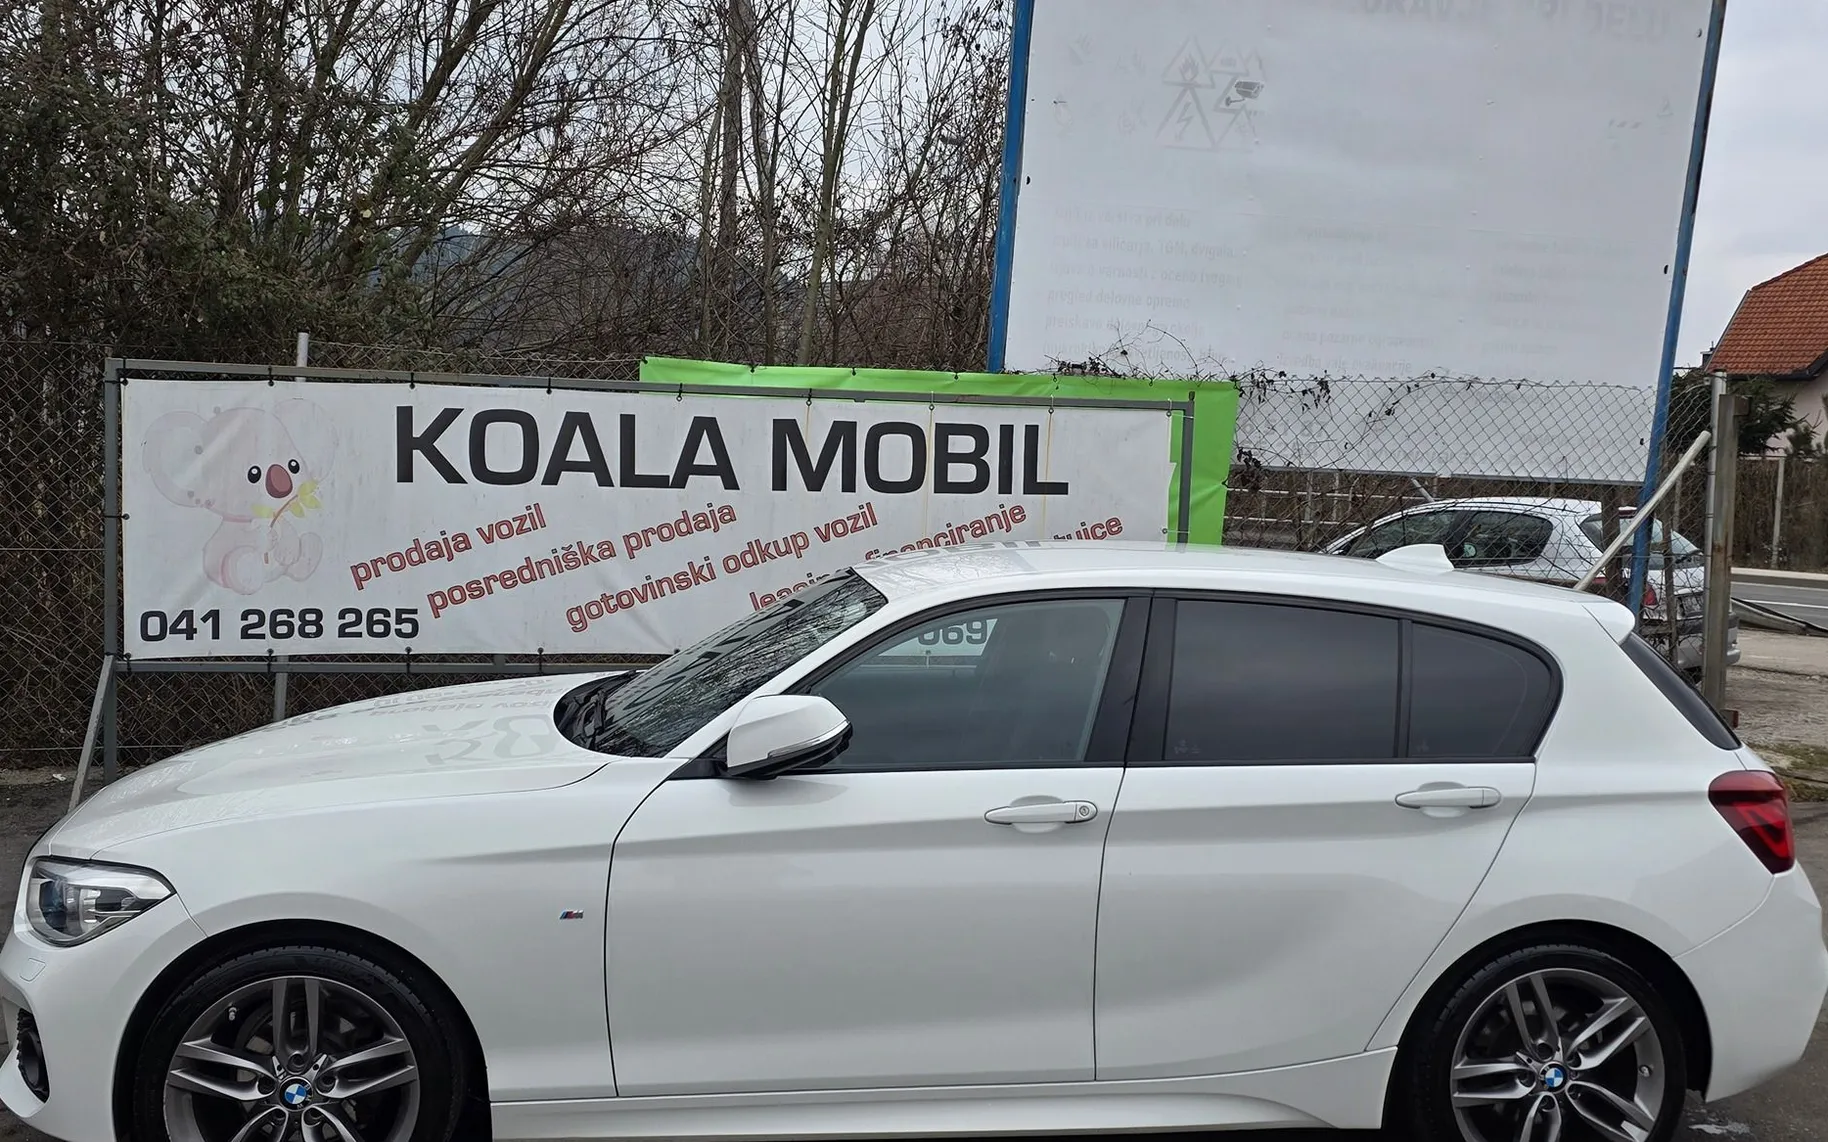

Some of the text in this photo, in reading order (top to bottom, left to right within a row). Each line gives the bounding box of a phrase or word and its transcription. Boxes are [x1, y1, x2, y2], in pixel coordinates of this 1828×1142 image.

[396, 405, 1069, 496] KOALA MOBIL
[350, 503, 547, 591] prodaja vozil
[427, 502, 737, 620] posredniška prodaja
[565, 502, 878, 633] gotovinski odkup vozil
[865, 503, 1027, 561] fanciranje
[139, 607, 420, 643] 041 268 265
